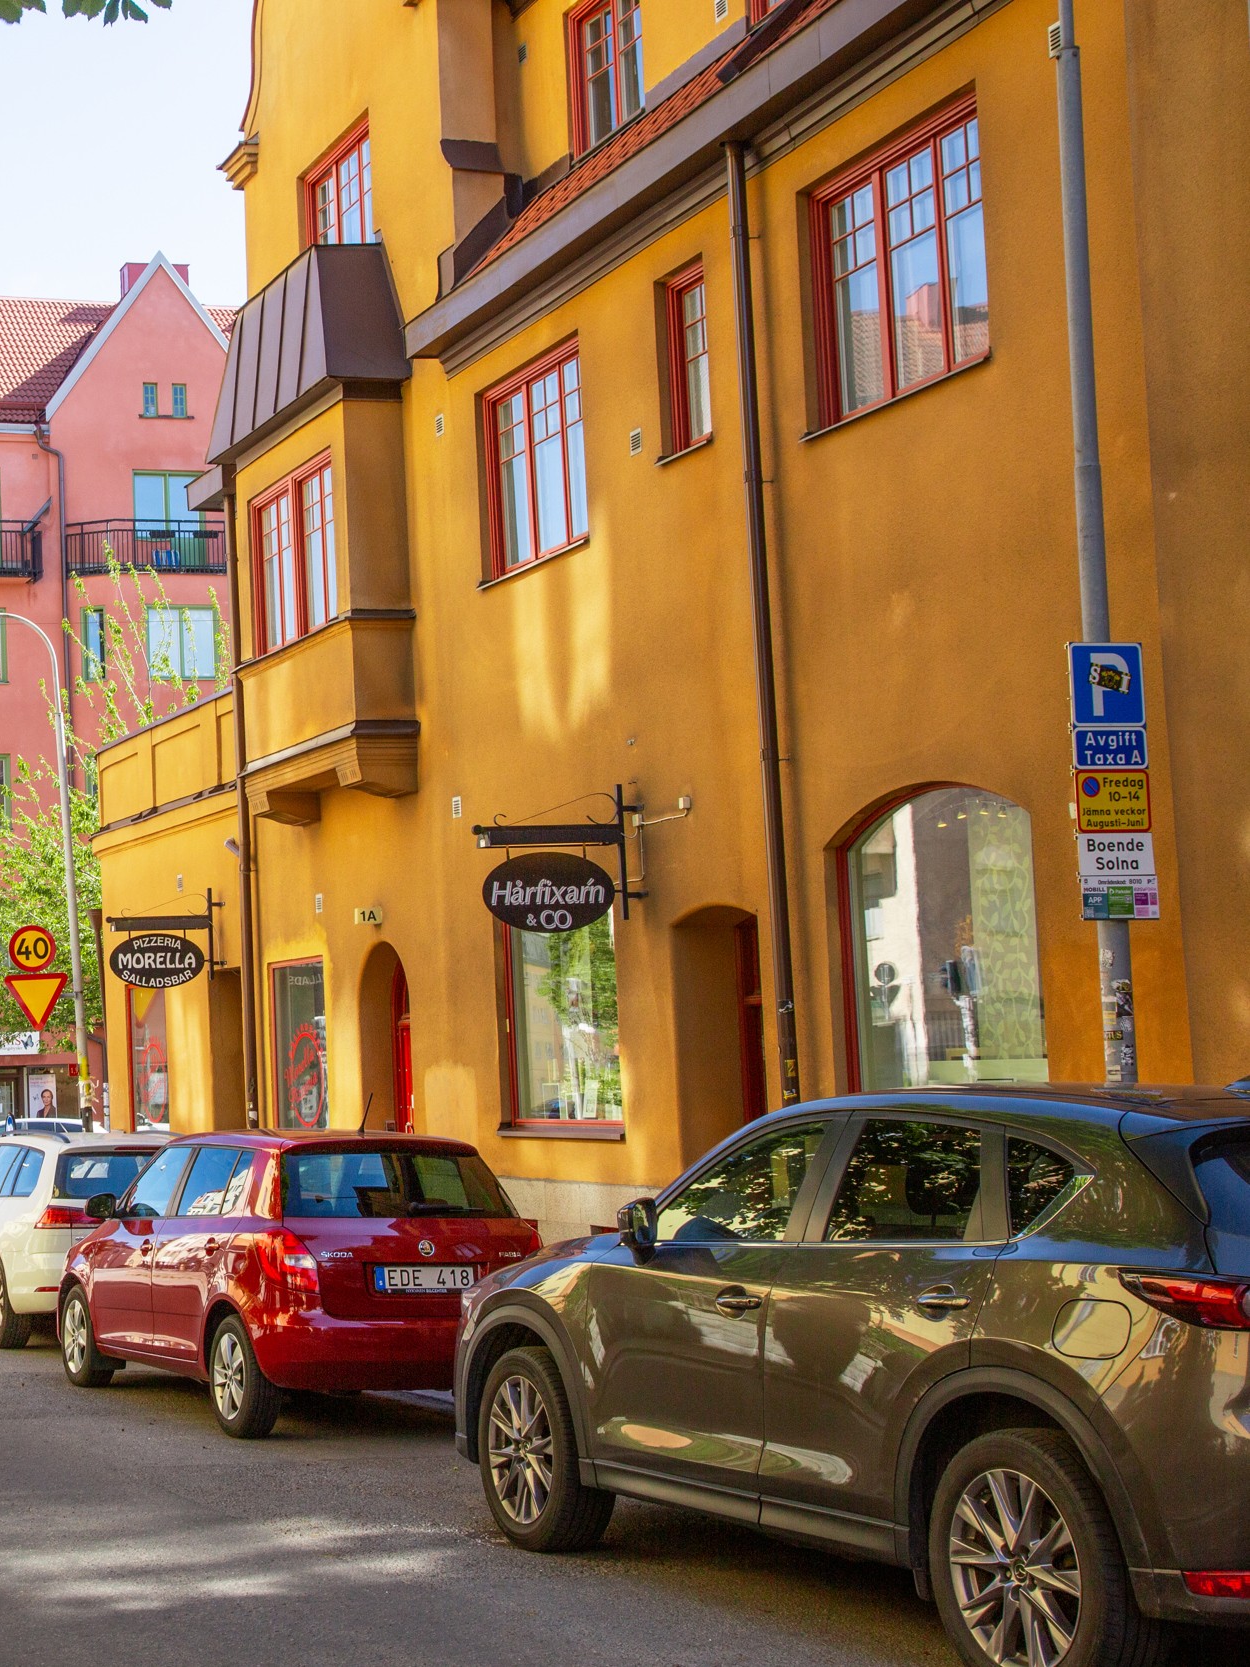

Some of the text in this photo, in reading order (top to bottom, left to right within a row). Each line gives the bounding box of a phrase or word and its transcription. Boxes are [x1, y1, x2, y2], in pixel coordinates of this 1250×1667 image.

[1085, 732, 1137, 749] Avgift
[1084, 750, 1142, 765] Taxa A
[1102, 777, 1144, 790] Fredag
[1108, 791, 1140, 802] 10-14
[1082, 807, 1146, 817] Jämna veckor
[1086, 818, 1144, 829] Augusti-Juni
[1086, 838, 1145, 852] Boende
[1095, 856, 1139, 870] Solna
[1088, 896, 1103, 904] APP
[360, 910, 377, 922] 1A
[526, 909, 573, 929] & CO
[16, 937, 49, 961] 40
[132, 936, 182, 950] PIZZERIA
[118, 952, 196, 969] MORELLA
[121, 969, 194, 988] SALLADSBAR
[387, 1269, 470, 1287] EDE 418
